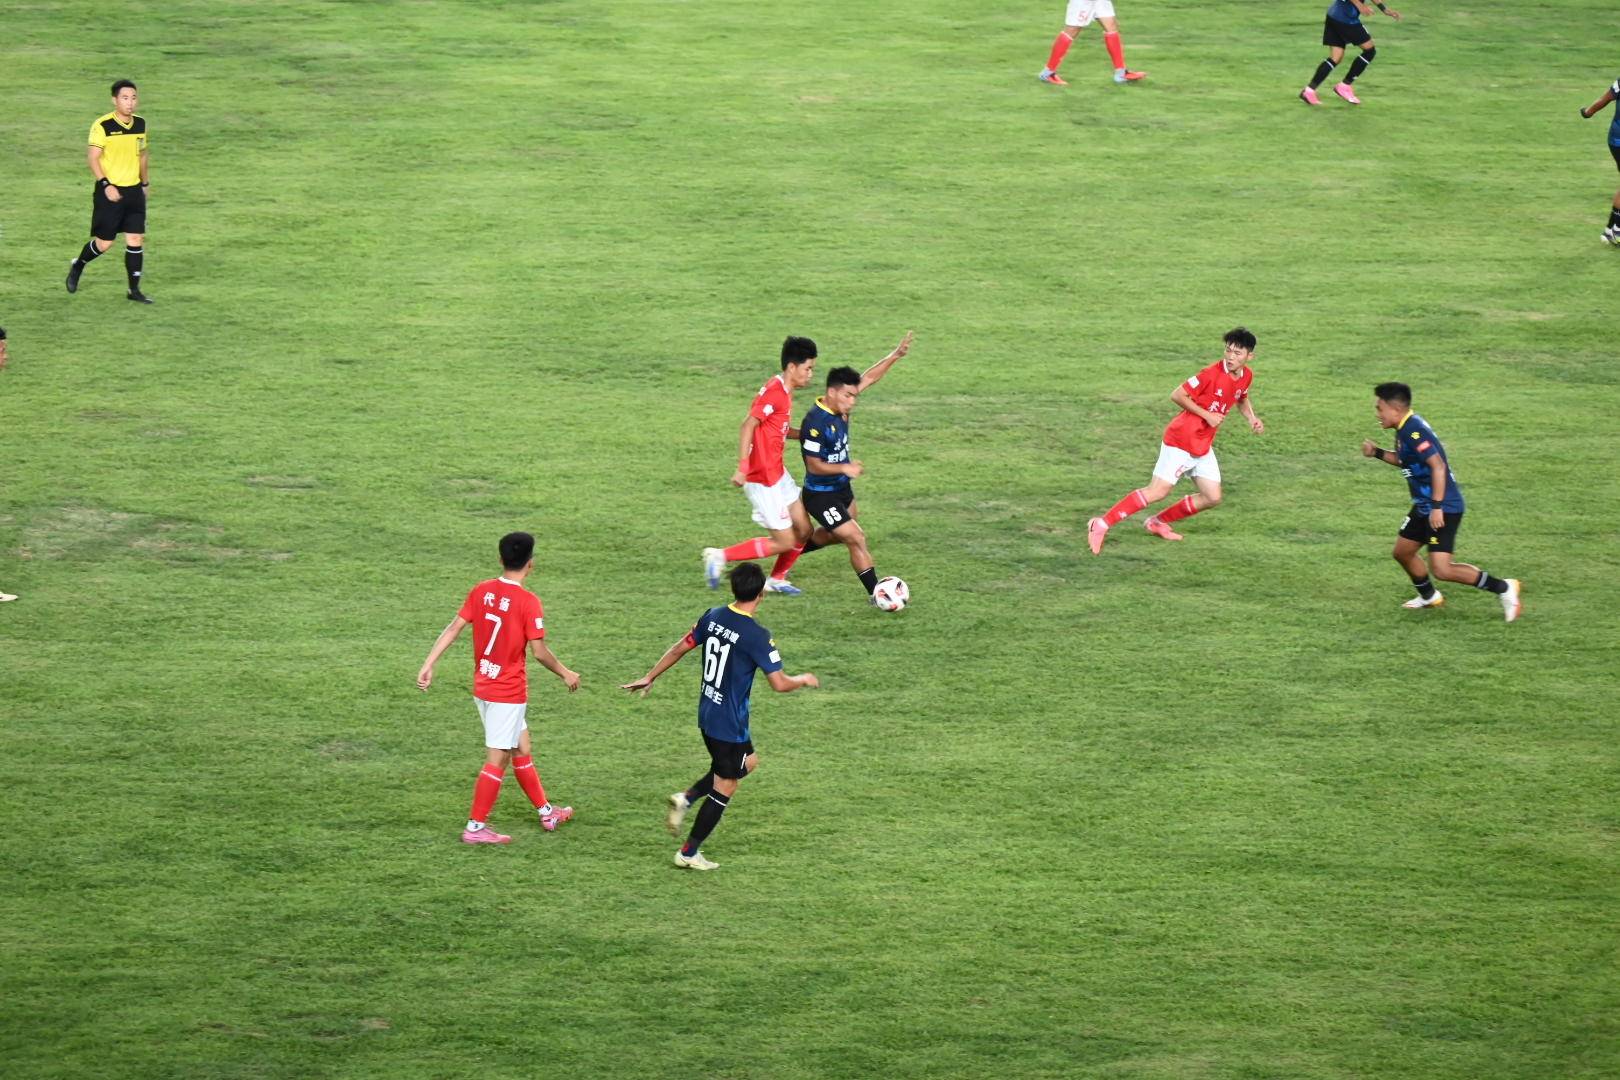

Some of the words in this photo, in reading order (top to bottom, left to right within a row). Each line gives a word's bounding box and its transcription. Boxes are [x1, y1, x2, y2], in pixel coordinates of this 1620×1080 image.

[823, 506, 842, 525] 65
[484, 612, 502, 656] 7
[703, 636, 731, 689] 61
